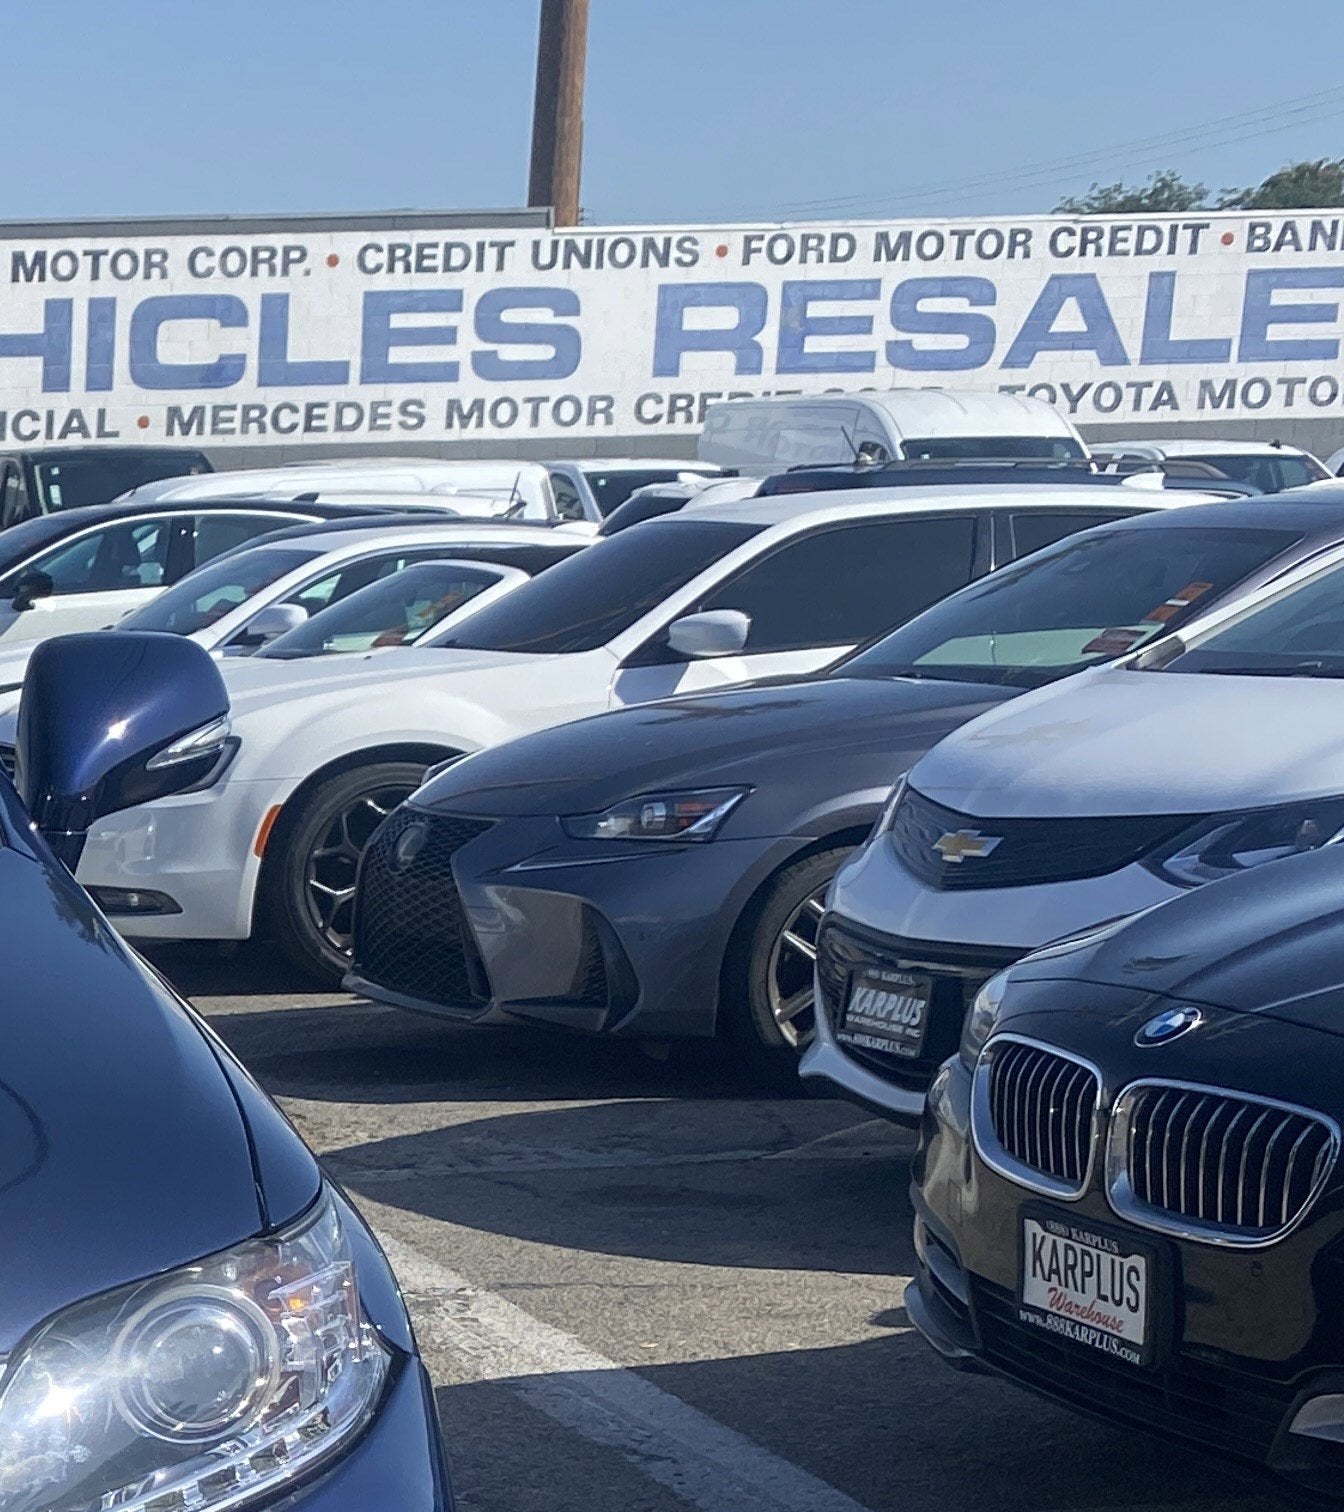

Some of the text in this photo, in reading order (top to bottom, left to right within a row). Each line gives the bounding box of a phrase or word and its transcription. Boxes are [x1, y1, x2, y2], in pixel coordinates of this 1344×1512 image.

[12, 246, 169, 284] MOTOR
[188, 243, 311, 279] CORP.
[356, 240, 514, 275] CREDIT
[531, 235, 700, 272] UNIONS
[741, 231, 857, 267] FORD
[873, 227, 1032, 263] MOTOR
[1049, 222, 1210, 259] CREDIT
[1245, 219, 1344, 254] BAN
[653, 266, 1344, 378] RESALE
[165, 400, 425, 440] MERCEDES
[445, 394, 614, 430] MOTOR
[1197, 375, 1344, 410] MOTO
[848, 986, 926, 1026] KARPLUS
[1032, 1231, 1141, 1314] KARPLUS
[1070, 1226, 1119, 1254] KARPLUS
[1047, 1286, 1125, 1334] Warehouse
